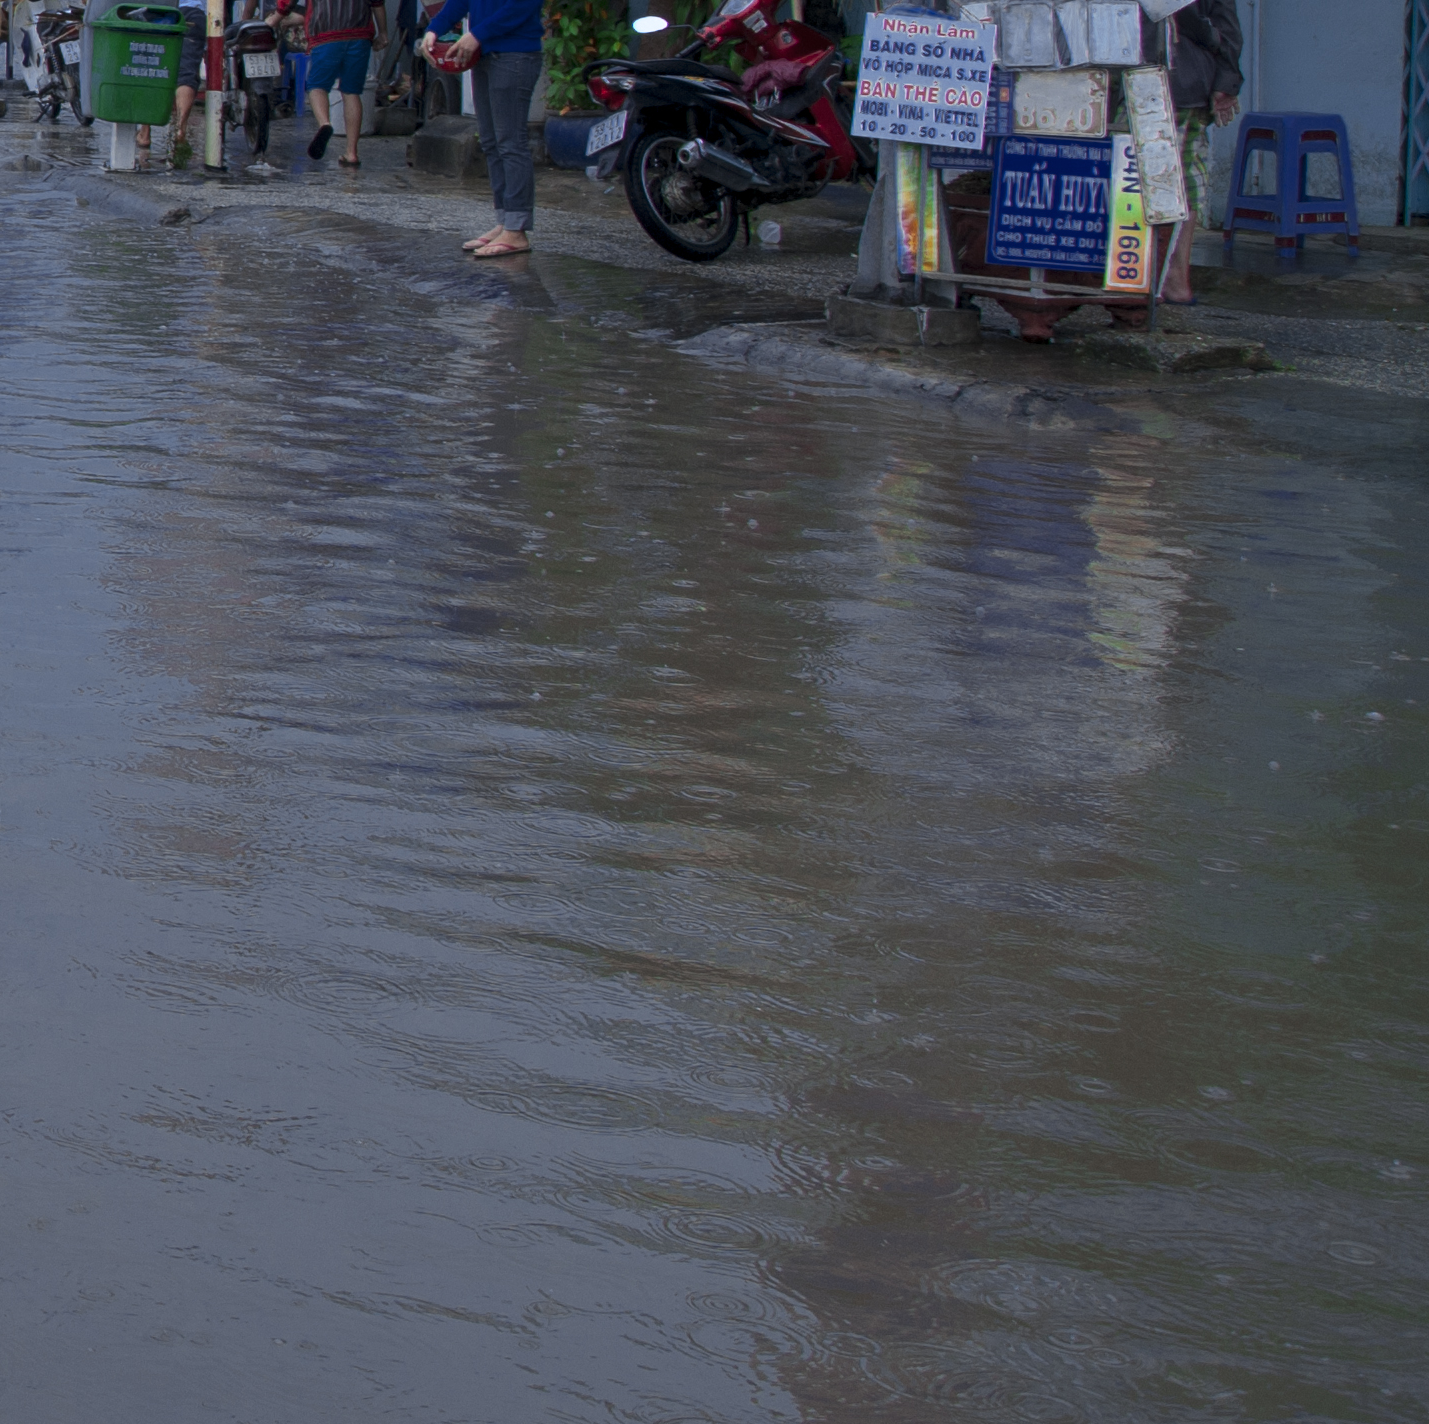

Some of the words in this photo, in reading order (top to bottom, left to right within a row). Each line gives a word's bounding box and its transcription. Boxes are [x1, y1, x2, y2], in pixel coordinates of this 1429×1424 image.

[883, 18, 930, 38] Nhận
[936, 24, 975, 39] Làm
[869, 35, 916, 56] BẢNG
[922, 41, 946, 58] SỐ
[950, 46, 985, 63] NHÀ
[884, 58, 913, 78] HỘP
[917, 64, 952, 79] MICA
[956, 68, 987, 83] S.XE
[860, 77, 897, 99] BÁN
[904, 80, 939, 103] THẺ
[945, 85, 982, 107] CÀO
[860, 100, 888, 117] MOBI
[897, 104, 924, 120] VINA
[934, 108, 979, 128] VIETTEL
[860, 120, 876, 132] 10
[890, 123, 906, 135] 20
[919, 127, 936, 139] 50
[951, 130, 976, 143] 100
[1003, 160, 1056, 210] TUẤN
[1001, 214, 1032, 230] DỊCH
[1035, 217, 1052, 233] VỤ
[996, 232, 1022, 243] CHO
[1025, 230, 1057, 246] THUÊ
[1060, 236, 1076, 246] XE
[1079, 238, 1095, 248] DU
[1116, 224, 1141, 281] 1668
